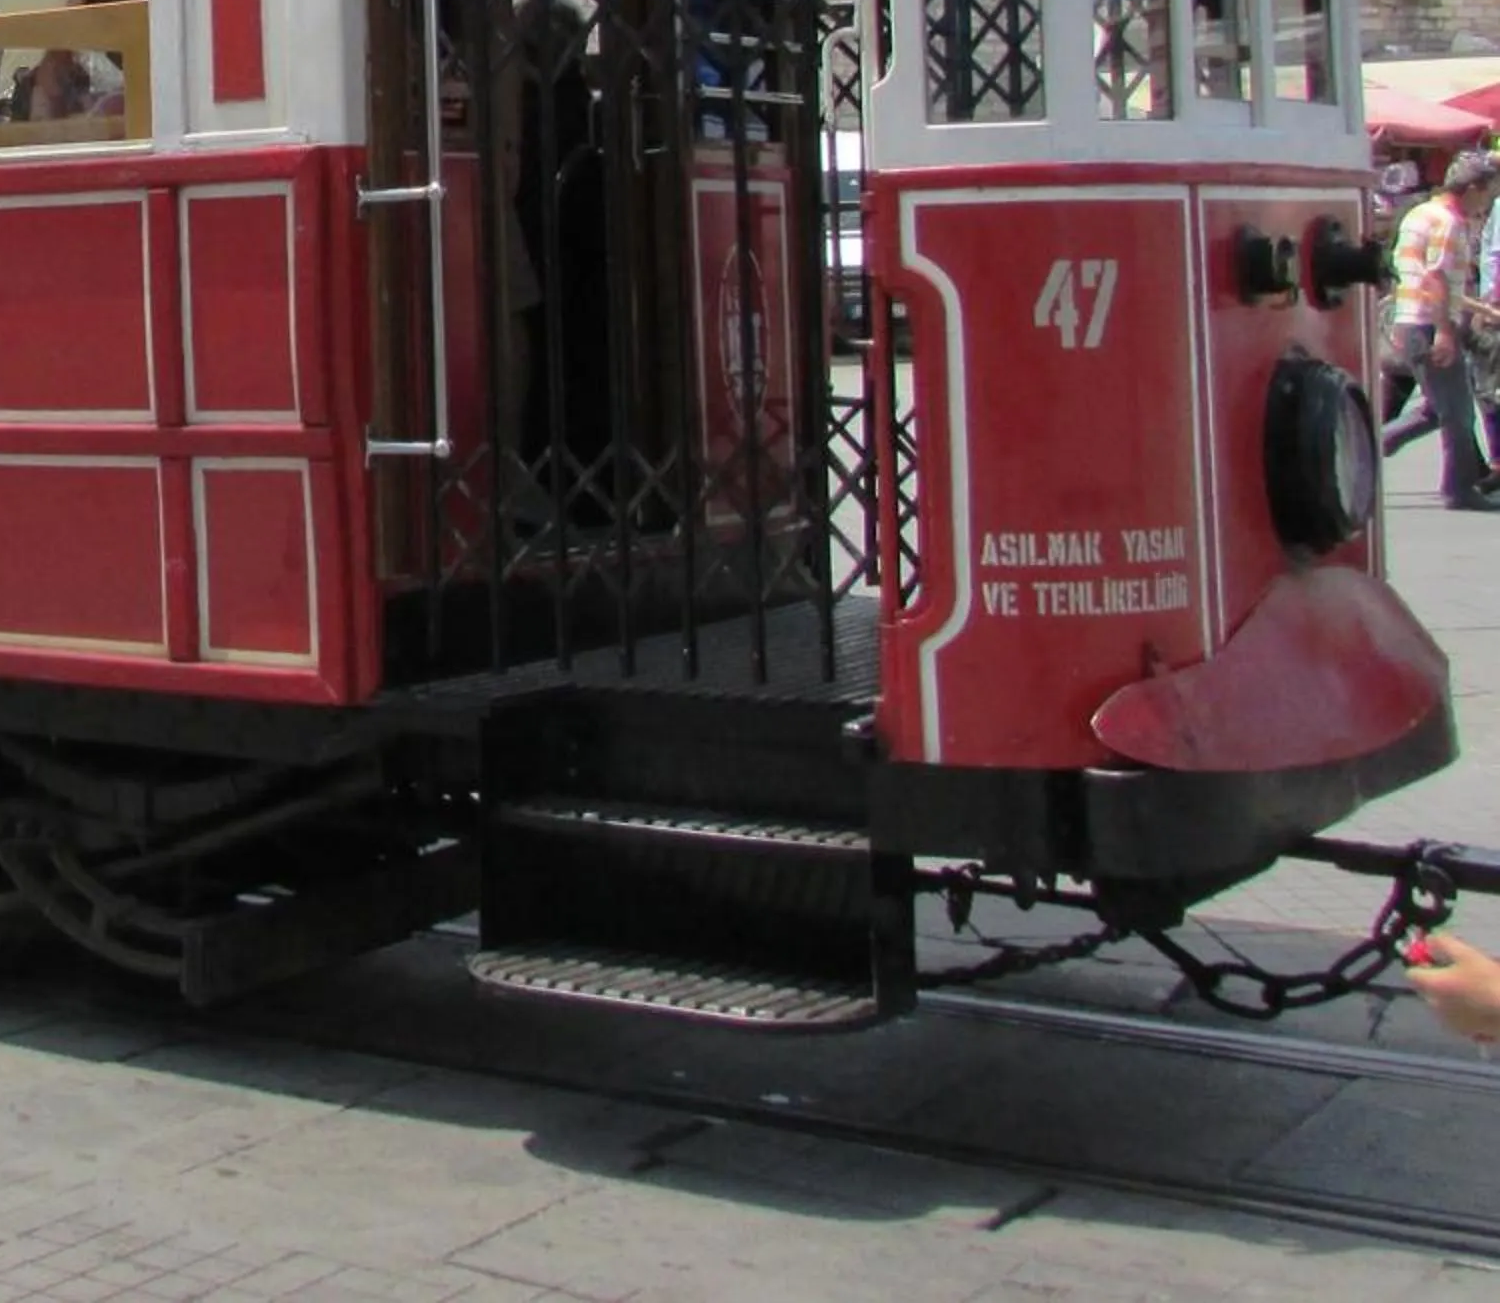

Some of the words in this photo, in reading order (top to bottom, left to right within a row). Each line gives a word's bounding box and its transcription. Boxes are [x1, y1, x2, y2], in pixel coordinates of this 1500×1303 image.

[1033, 258, 1119, 350] 47
[980, 530, 1103, 567] ASILMAK
[1120, 525, 1186, 564] YASAK
[981, 580, 1021, 617] VE
